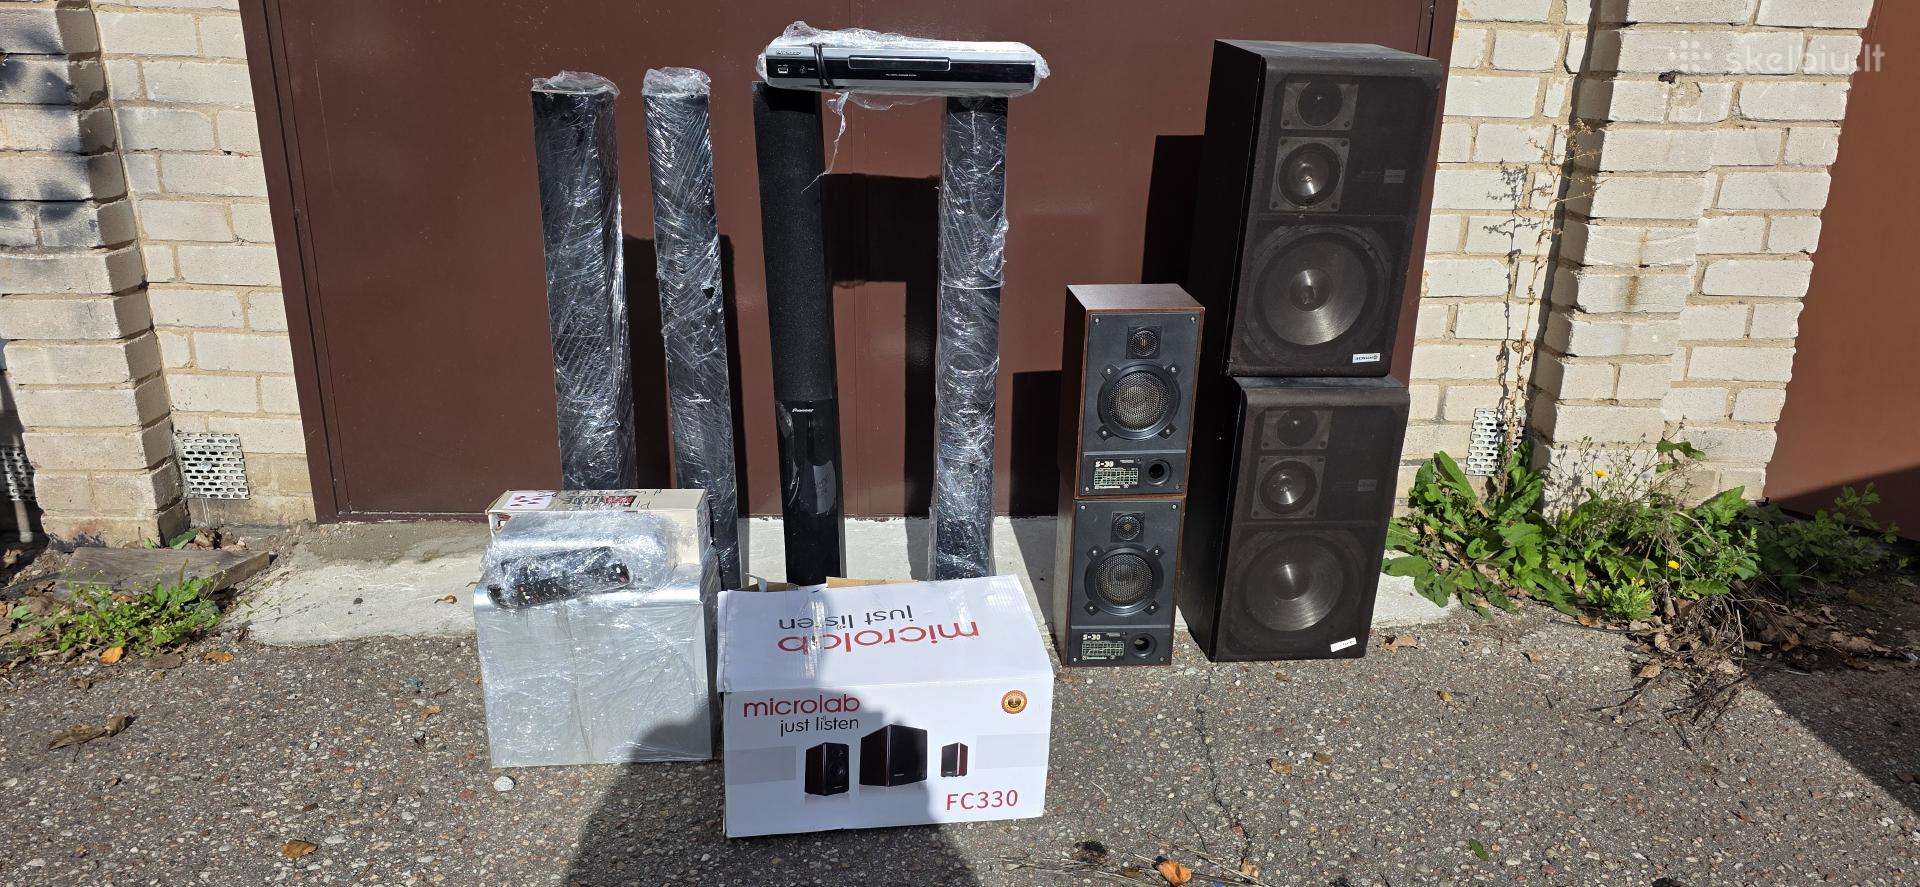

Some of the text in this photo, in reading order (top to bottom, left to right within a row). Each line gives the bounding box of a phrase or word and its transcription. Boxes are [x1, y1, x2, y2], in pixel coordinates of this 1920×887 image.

[779, 605, 913, 629] just lisen
[743, 694, 860, 717] microlab
[779, 716, 859, 737] just listen
[946, 789, 1018, 811] FC330
